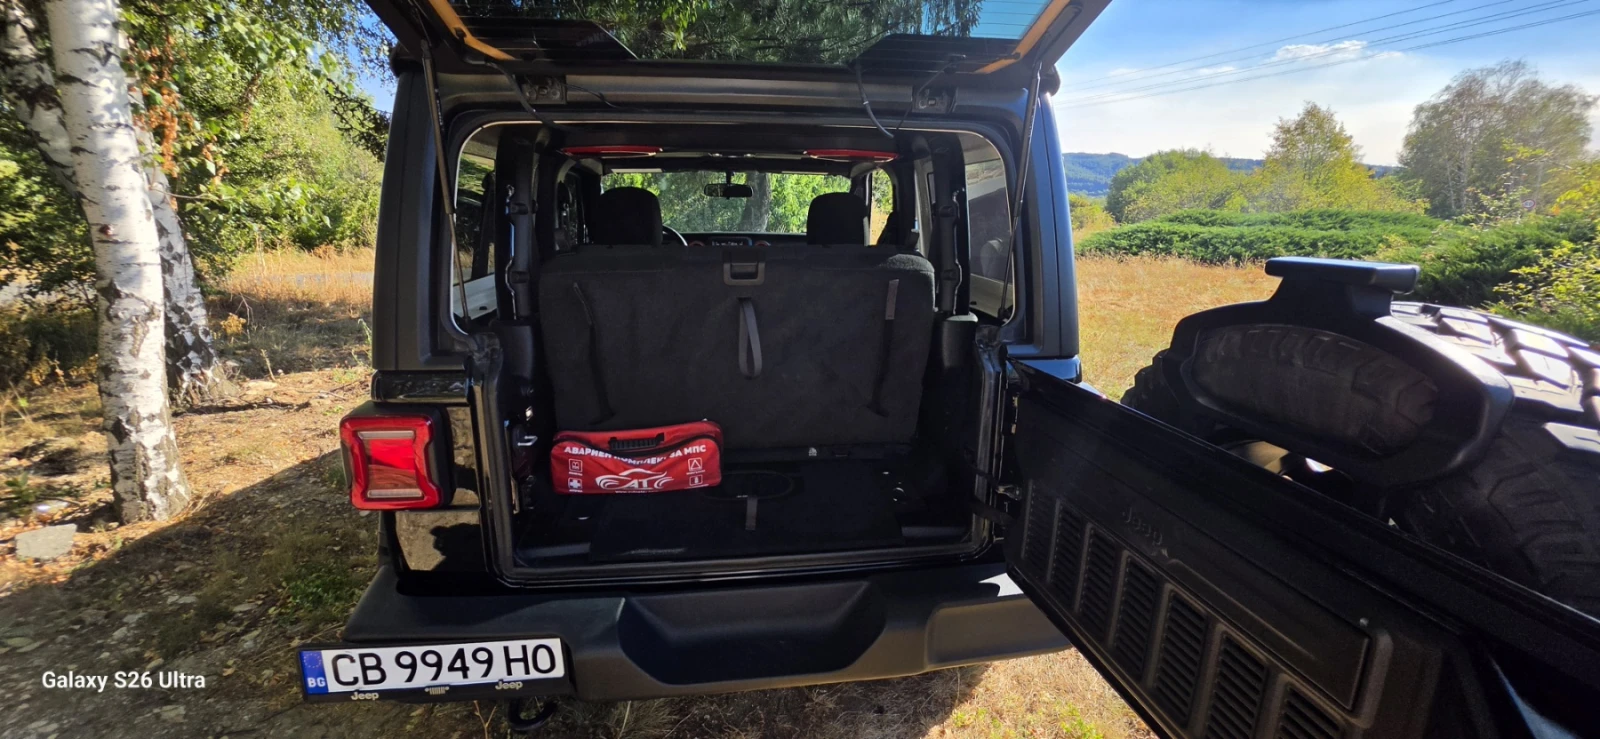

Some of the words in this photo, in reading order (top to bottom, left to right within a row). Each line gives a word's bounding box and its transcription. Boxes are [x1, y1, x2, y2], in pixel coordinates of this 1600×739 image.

[683, 444, 707, 456] МПС
[331, 652, 387, 686] CB
[394, 646, 494, 683] 9949
[503, 643, 556, 677] HO
[307, 676, 326, 688] BG
[495, 679, 523, 691] Jeep
[350, 689, 380, 701] Jeep
